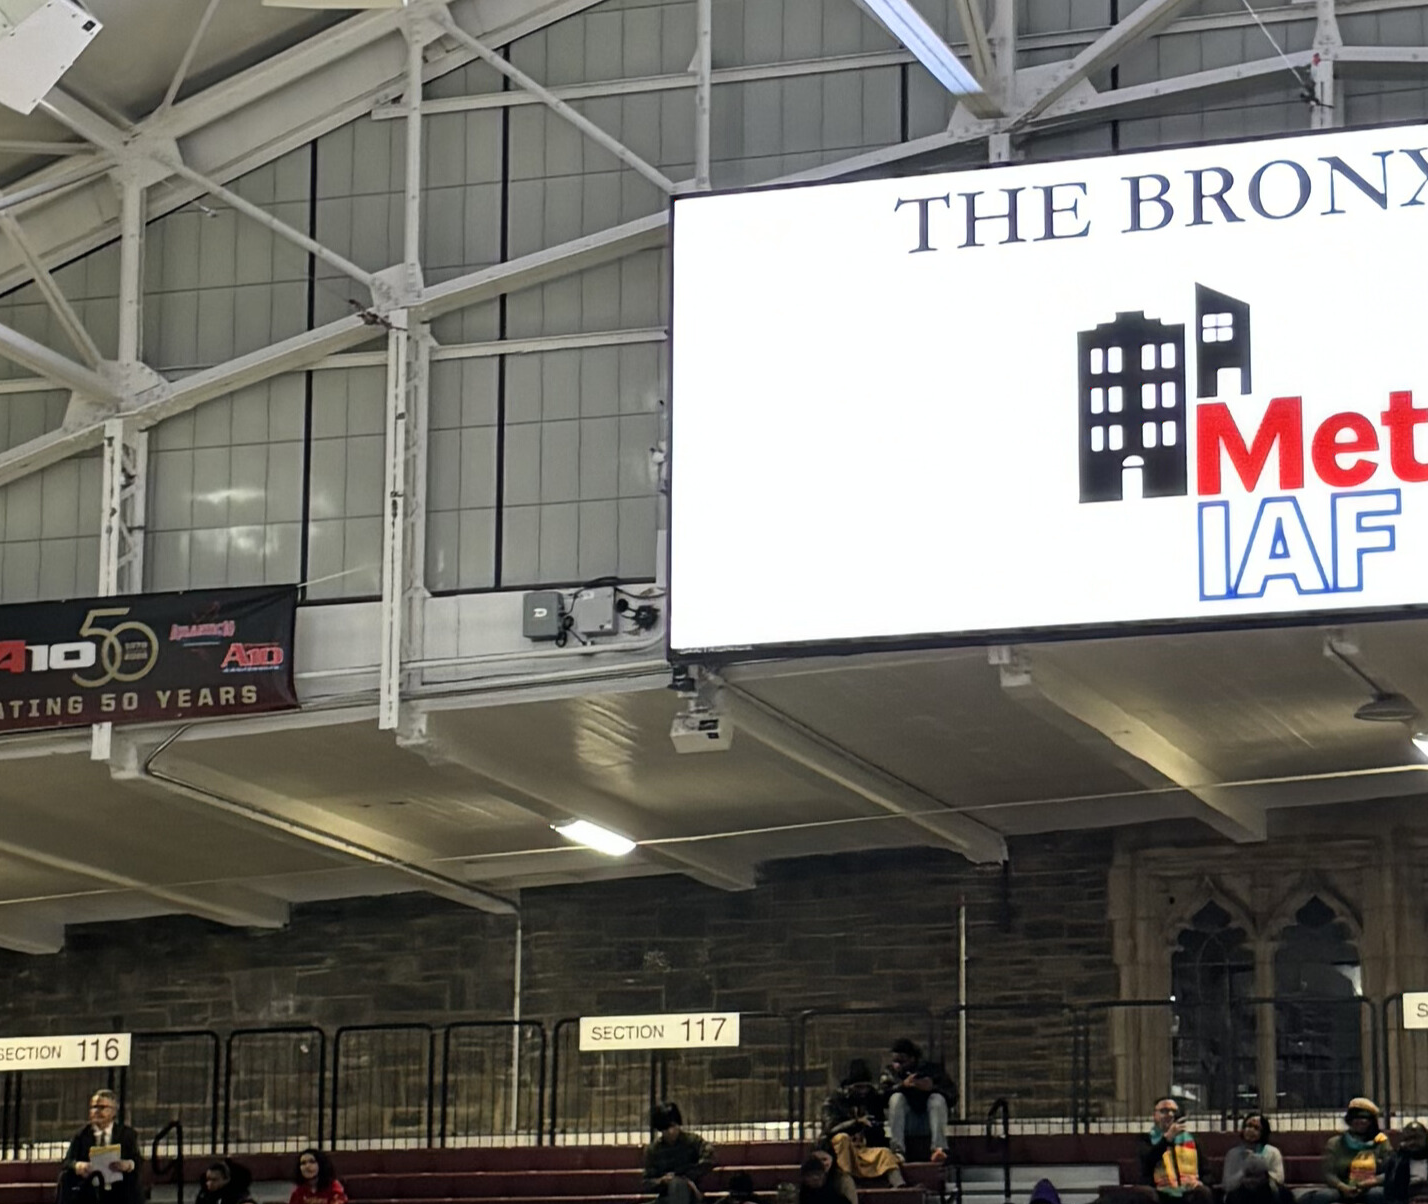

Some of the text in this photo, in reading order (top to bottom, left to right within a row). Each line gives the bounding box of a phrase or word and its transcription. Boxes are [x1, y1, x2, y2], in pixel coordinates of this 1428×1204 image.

[894, 181, 1091, 254] THE
[1198, 488, 1402, 601] IAF
[100, 691, 139, 713] 50
[156, 684, 259, 710] YEARS
[591, 1018, 727, 1042] SECTION 117
[77, 1038, 120, 1062] 116
